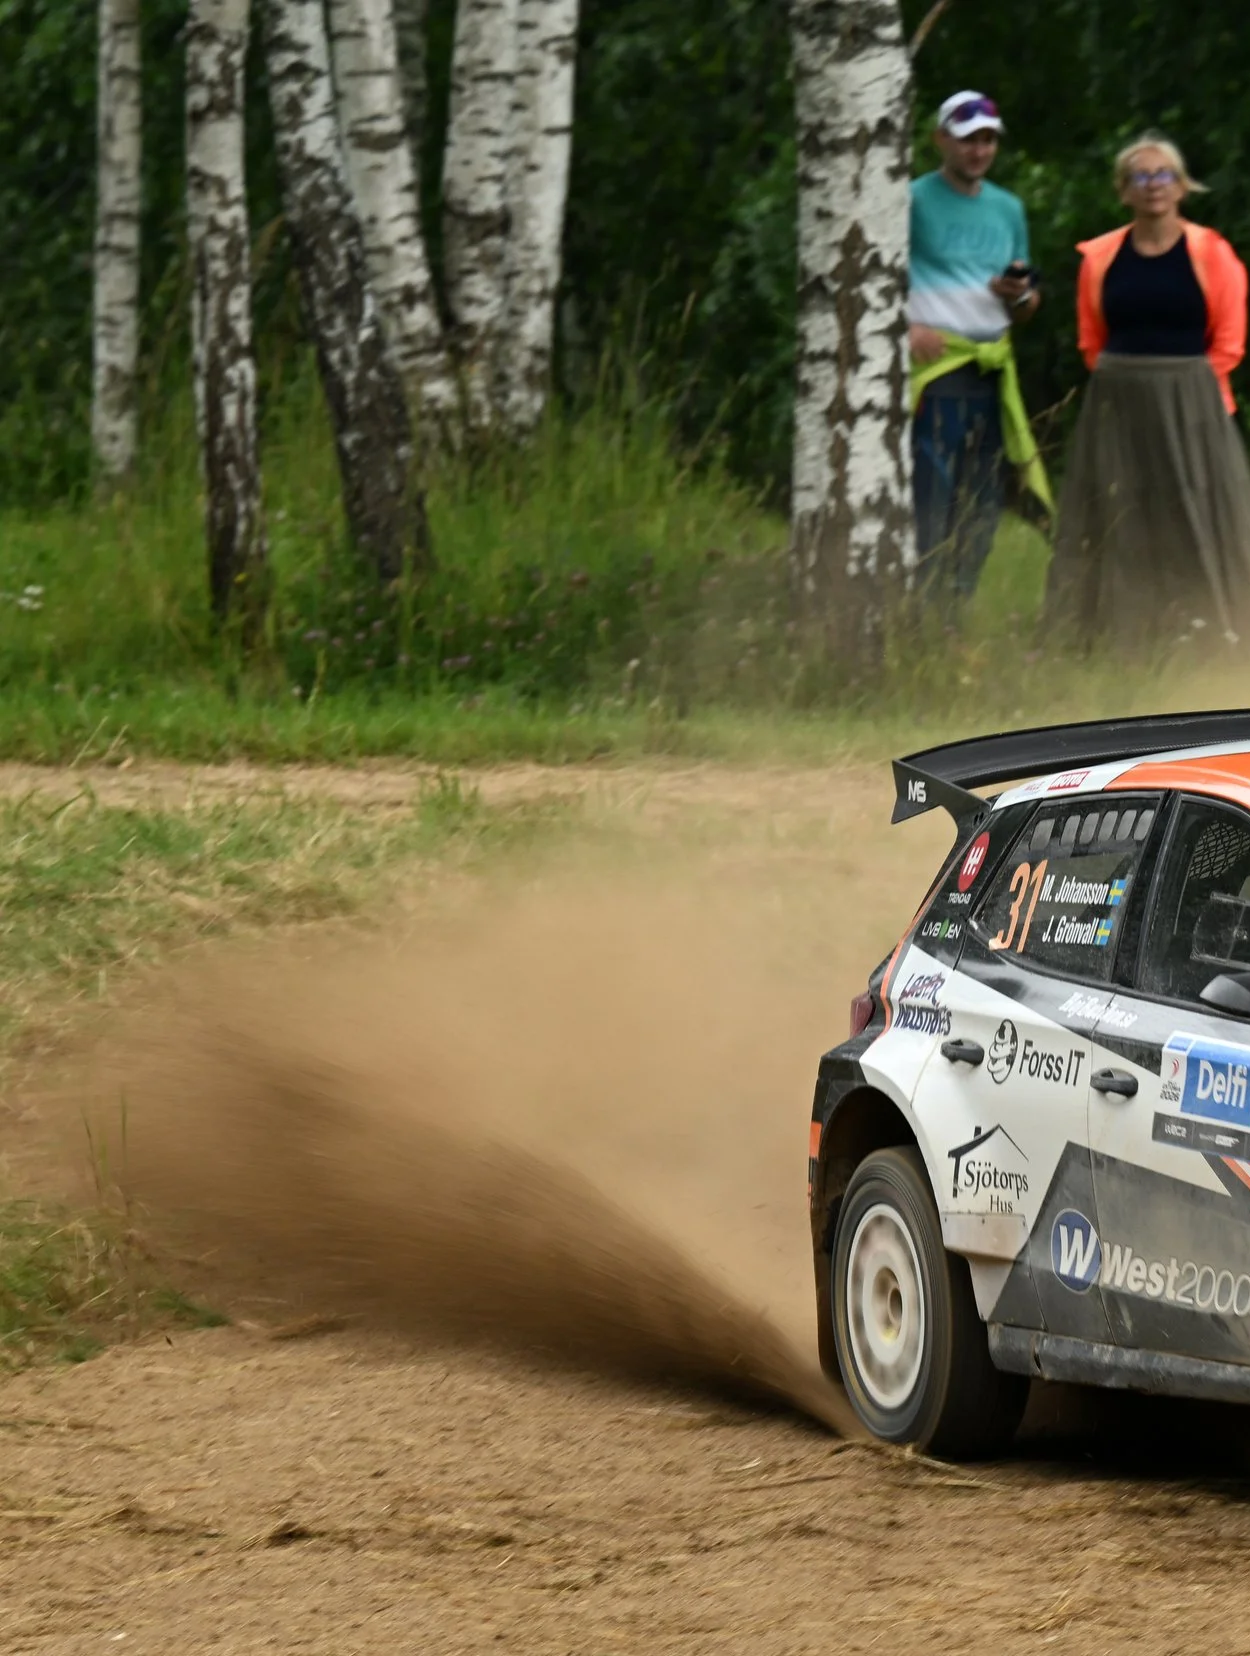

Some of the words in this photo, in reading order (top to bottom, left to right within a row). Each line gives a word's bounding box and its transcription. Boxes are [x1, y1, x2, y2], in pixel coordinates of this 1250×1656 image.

[987, 859, 1047, 954] 31
[1039, 873, 1053, 903] M.
[1055, 875, 1110, 905] Johansson
[1042, 922, 1053, 943] J.
[1054, 917, 1100, 945] Grönvall
[1019, 1039, 1064, 1083] Forss
[1065, 1048, 1086, 1087] IT
[1195, 1059, 1248, 1109] Delfi
[963, 1159, 1029, 1201] Sjötorps
[989, 1194, 1014, 1214] Hus
[1058, 1223, 1097, 1280] W
